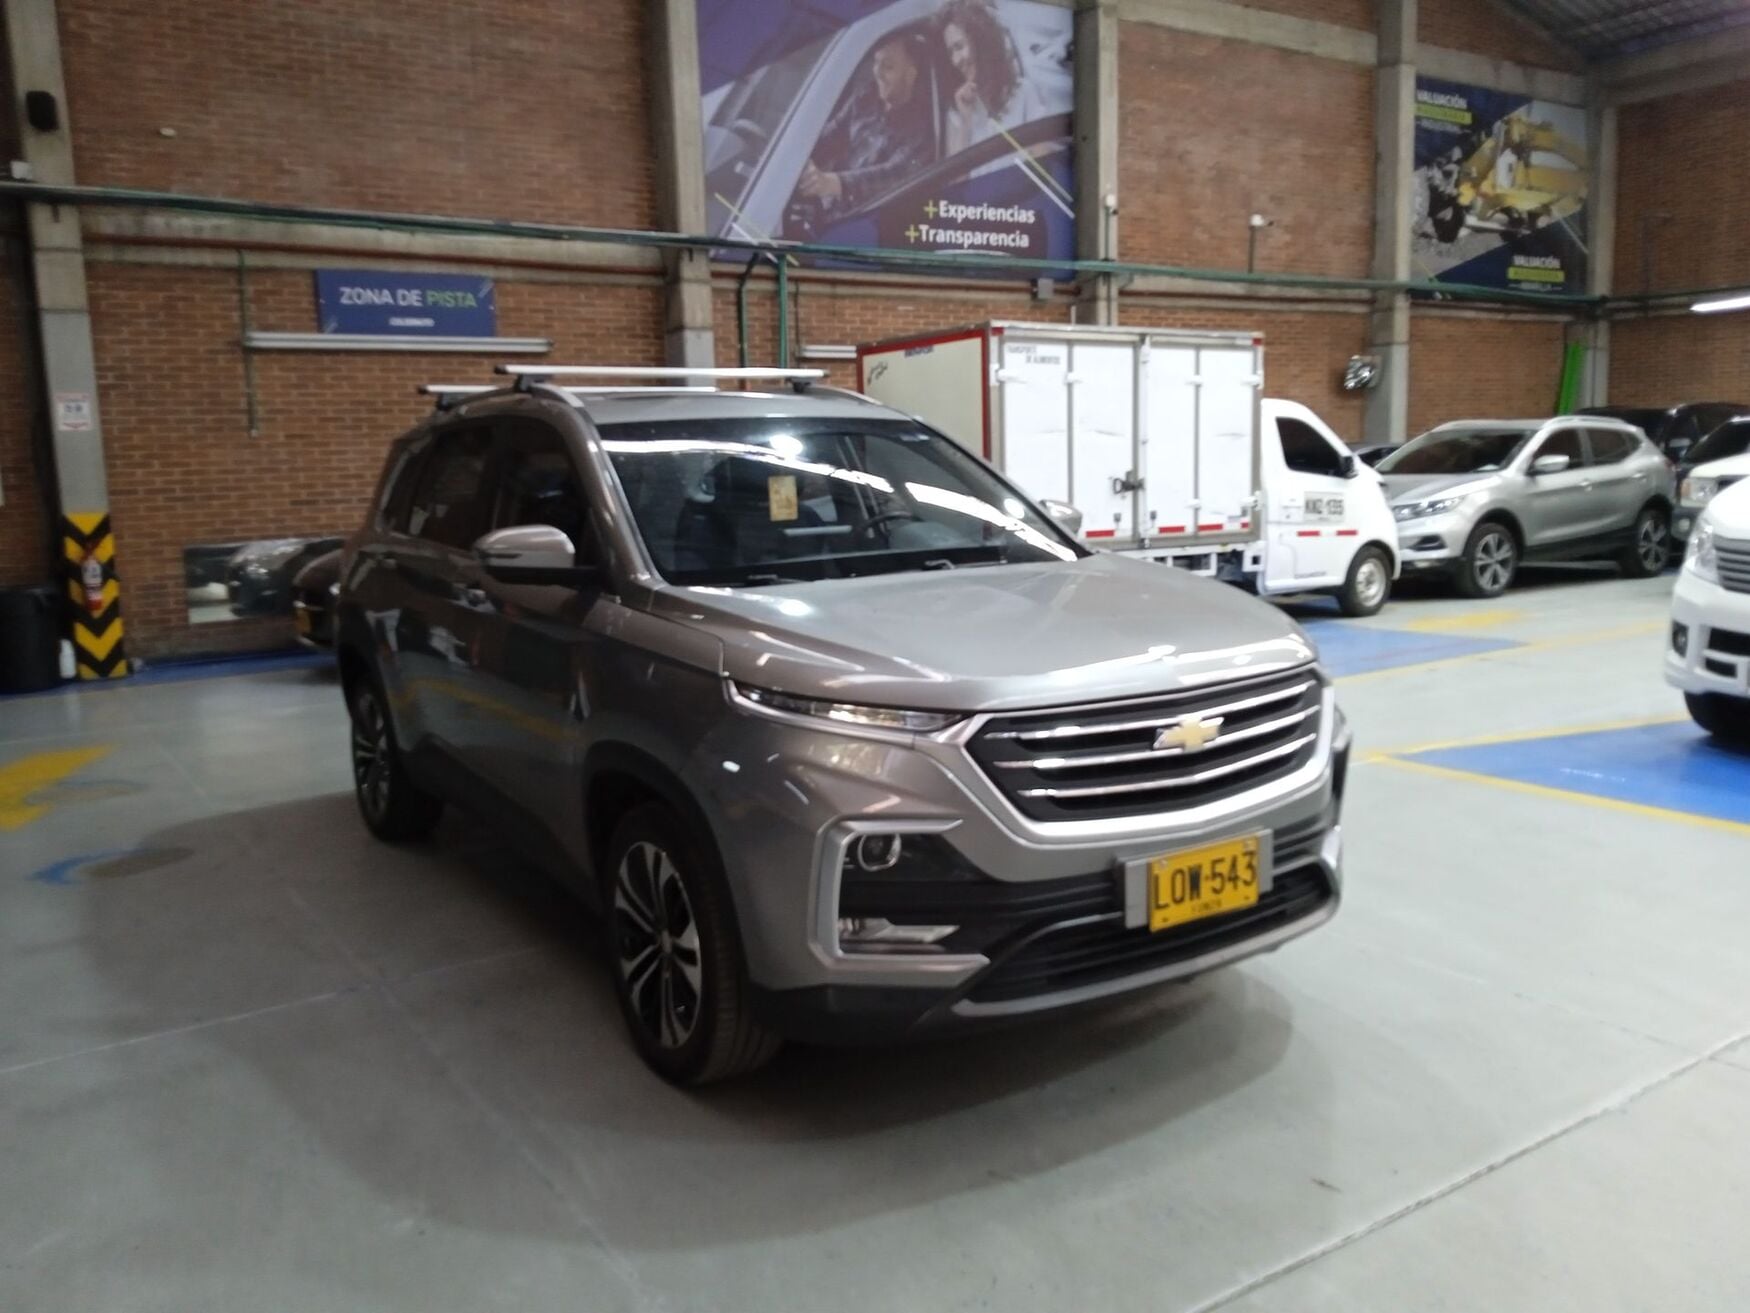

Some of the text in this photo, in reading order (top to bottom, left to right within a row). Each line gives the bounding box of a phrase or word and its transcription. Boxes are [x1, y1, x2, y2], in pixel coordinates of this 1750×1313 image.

[923, 199, 1036, 224] +Experiencias
[905, 223, 1030, 248] +Transparencia
[339, 286, 478, 308] ZONA DE PISTA
